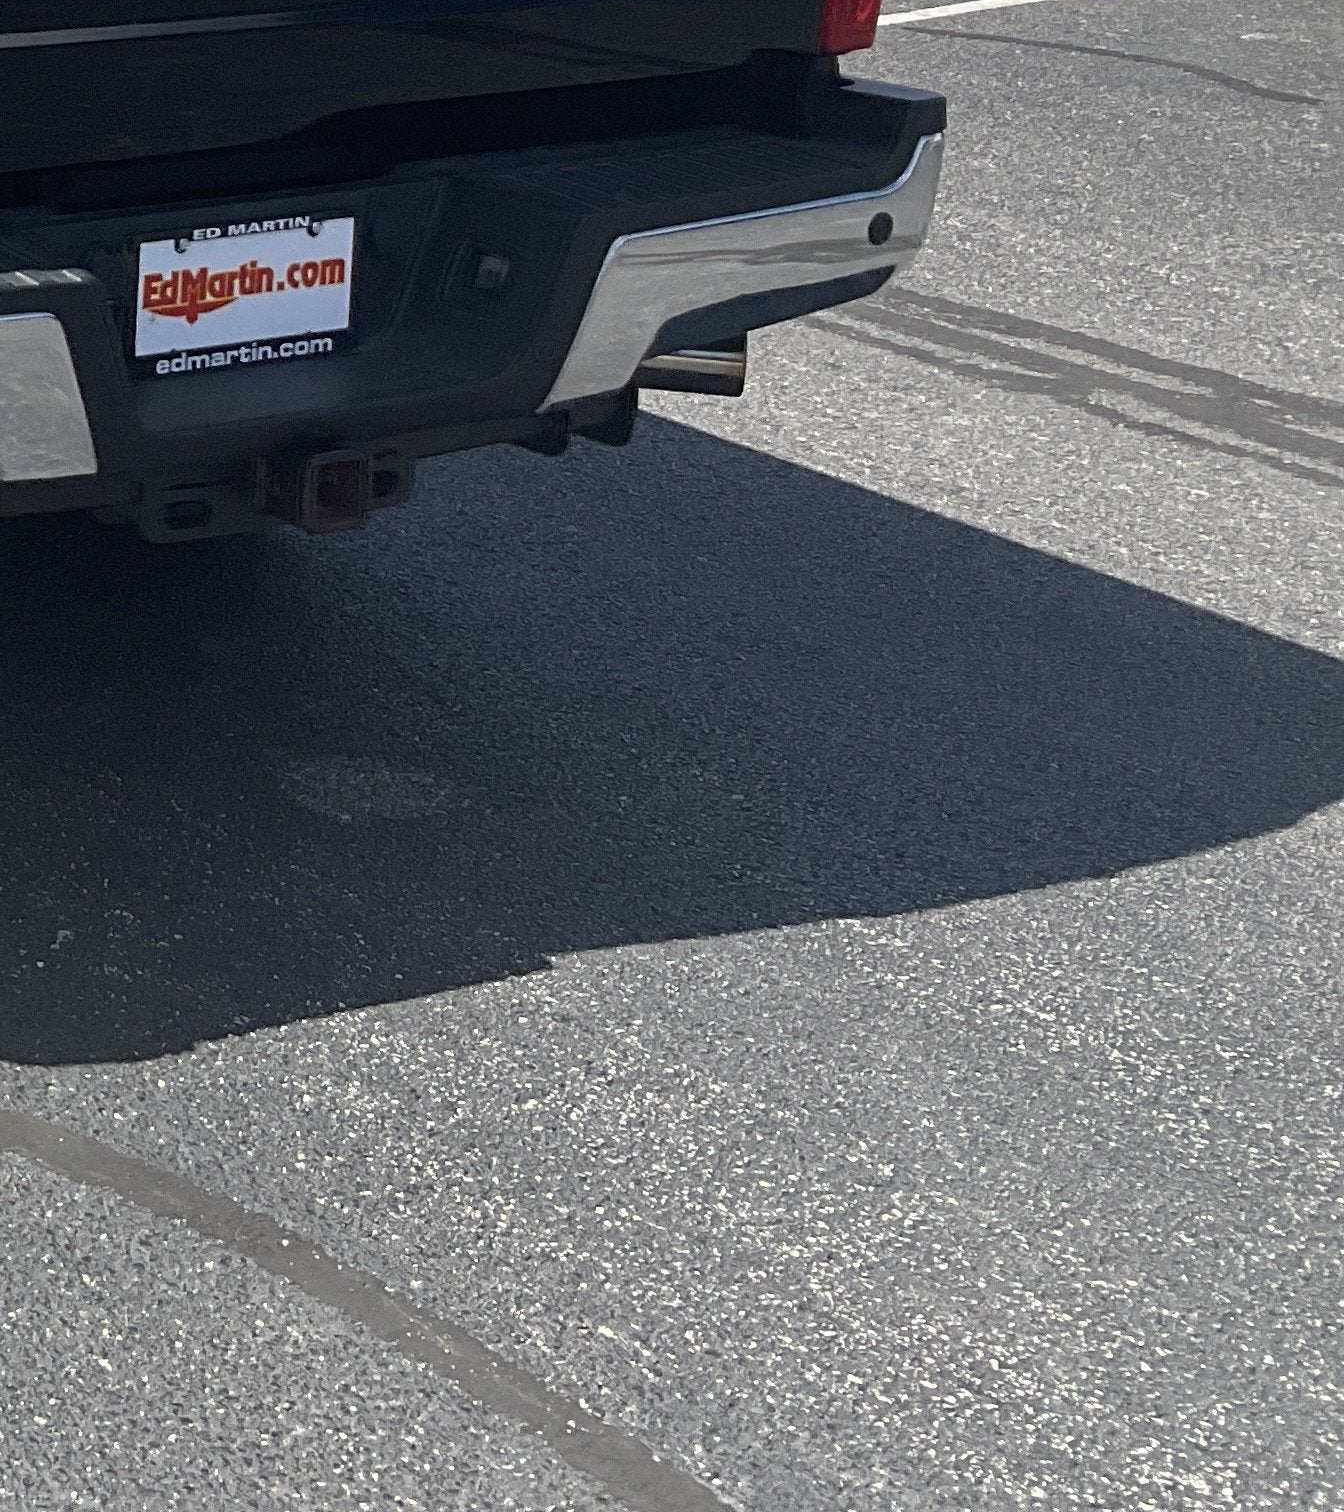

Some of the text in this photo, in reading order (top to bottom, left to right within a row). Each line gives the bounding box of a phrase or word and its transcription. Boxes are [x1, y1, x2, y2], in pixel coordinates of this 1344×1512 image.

[192, 215, 311, 241] ED MARTIN
[142, 258, 346, 312] EdMartin.com
[155, 337, 333, 375] edmartin.com
